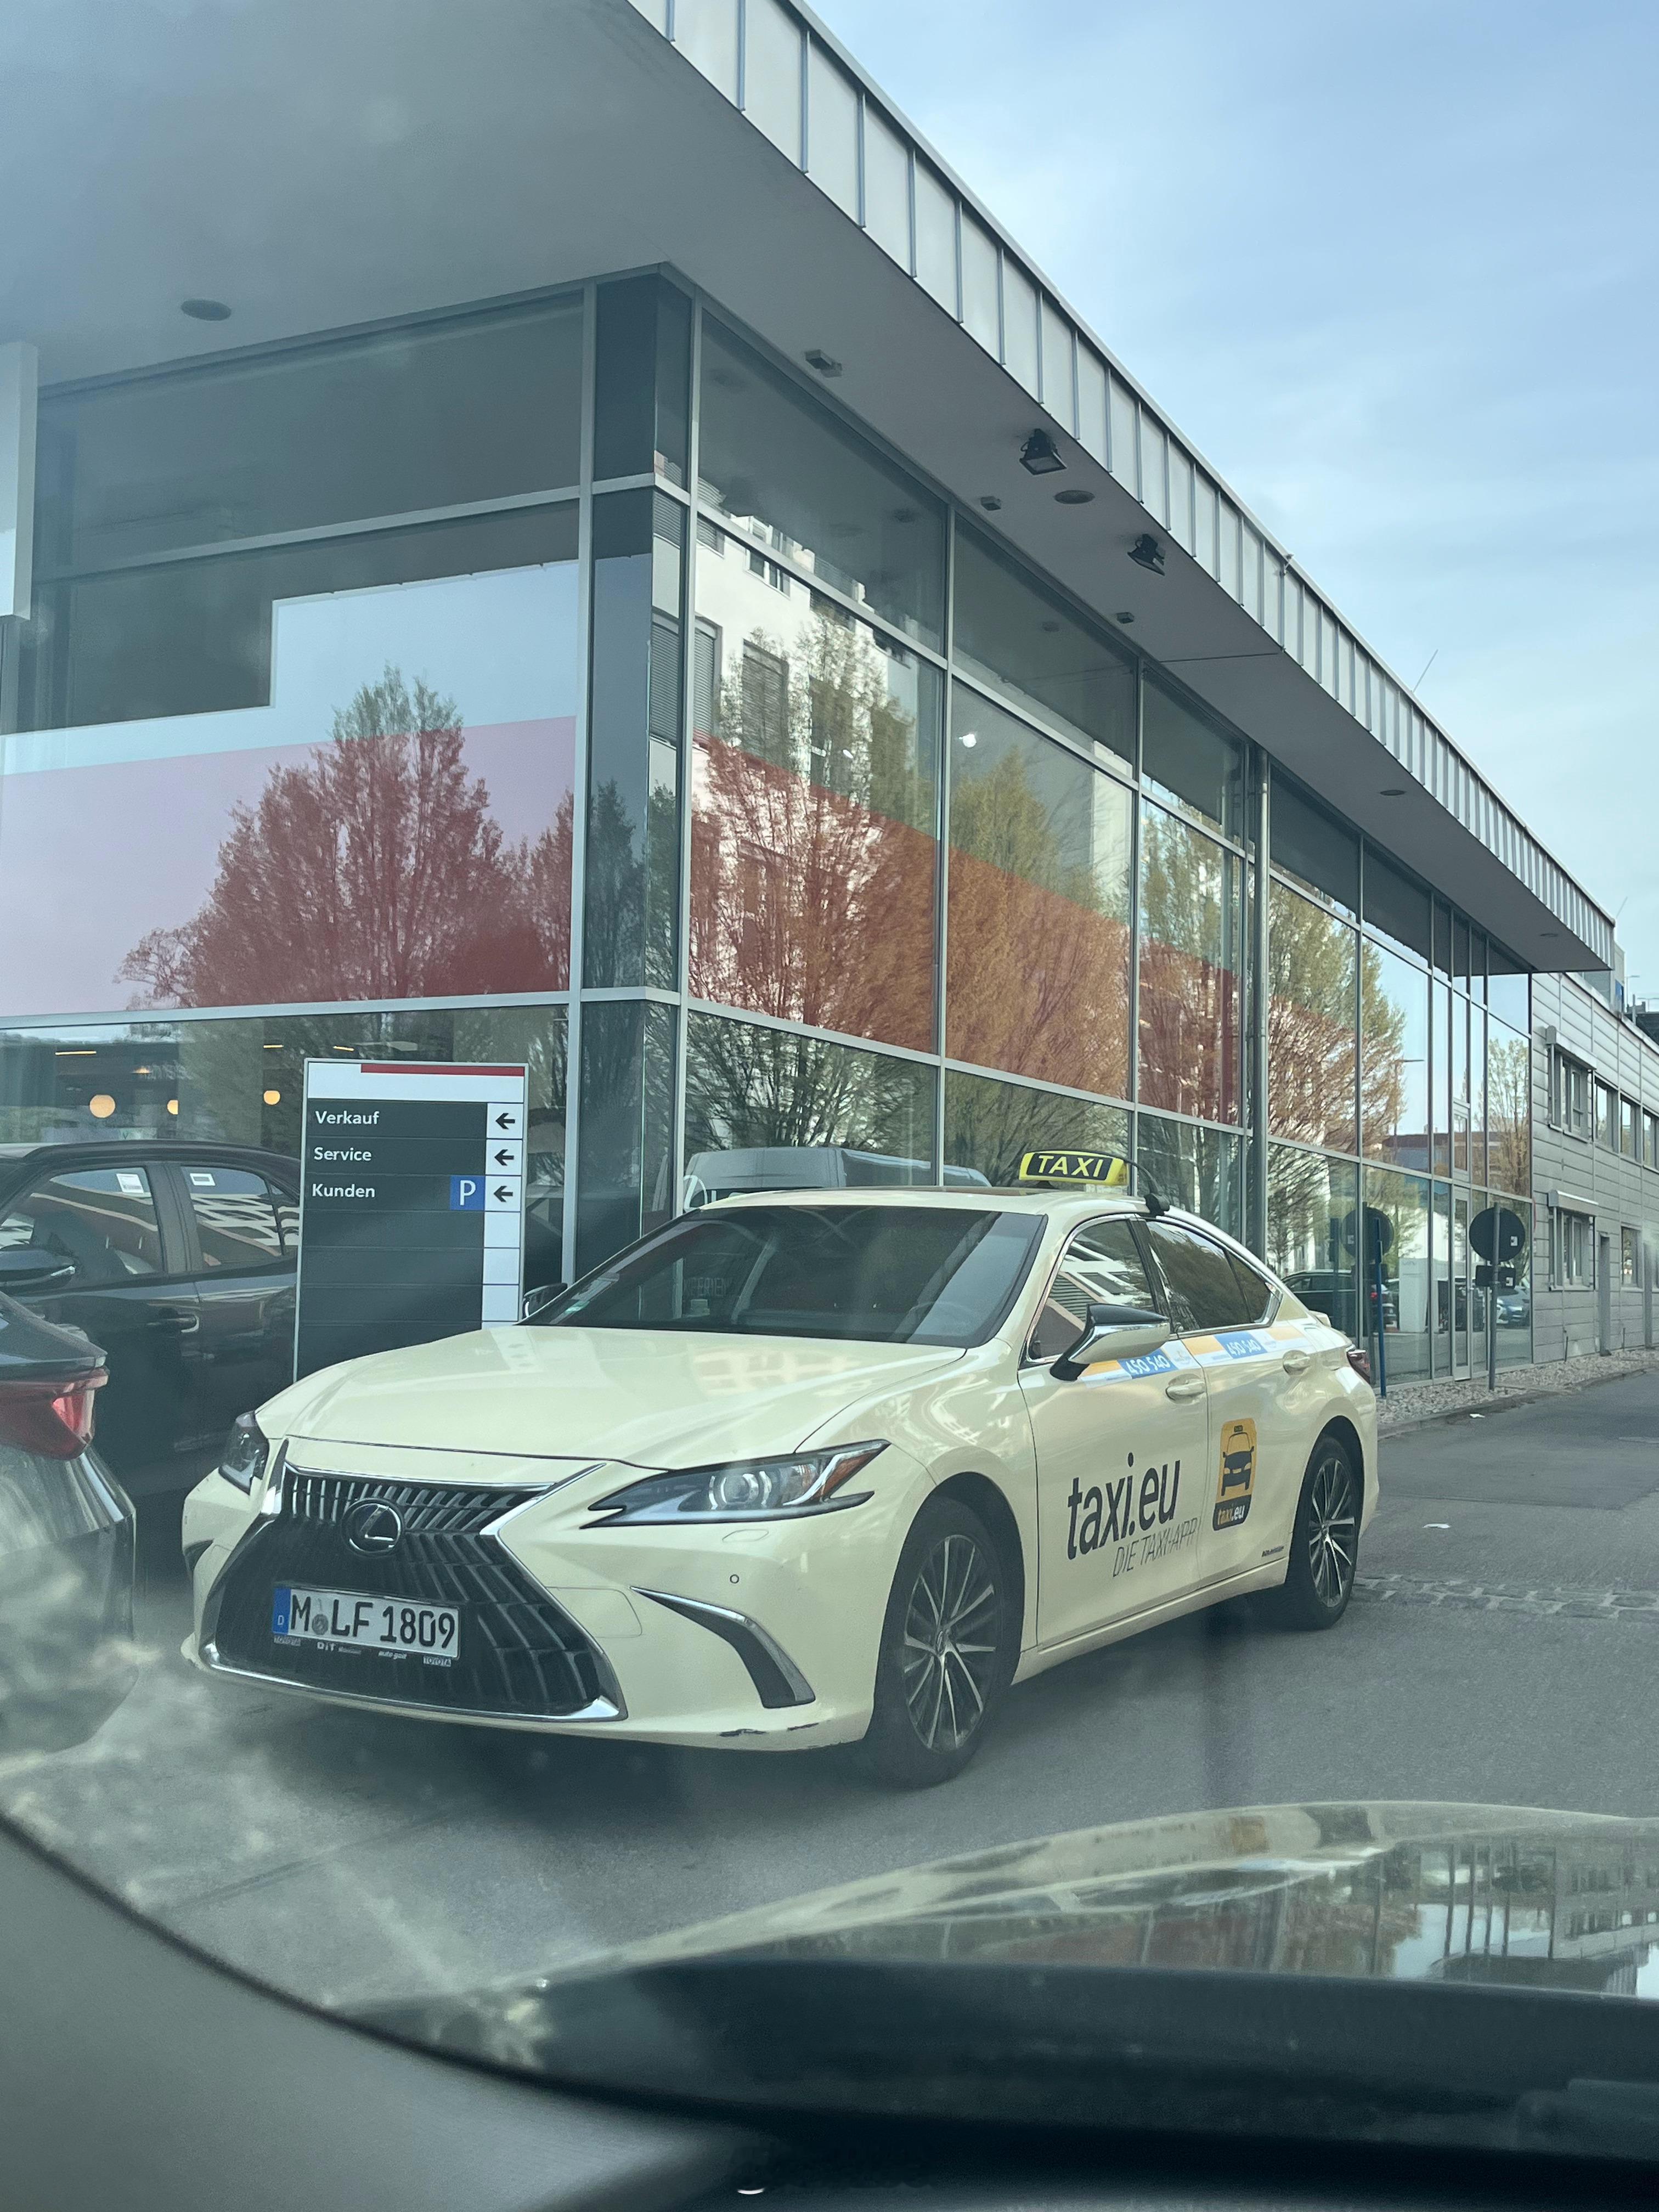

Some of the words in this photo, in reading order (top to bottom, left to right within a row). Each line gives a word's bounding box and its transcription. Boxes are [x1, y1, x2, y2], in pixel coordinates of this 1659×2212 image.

[315, 1110, 380, 1125] Verkauf
[314, 1147, 371, 1161] Service
[1039, 1155, 1103, 1177] TAXI
[313, 1184, 375, 1198] Kunden
[460, 1180, 476, 1205] P
[1126, 1358, 1150, 1374] 450
[1146, 1355, 1170, 1370] 540
[1068, 1452, 1180, 1560] taxi.eu
[1217, 1503, 1245, 1525] taxi.eu
[1113, 1540, 1139, 1577] DIE
[278, 1615, 284, 1626] D
[291, 1594, 311, 1631] M
[331, 1599, 373, 1637] LF
[380, 1606, 455, 1649] 1809
